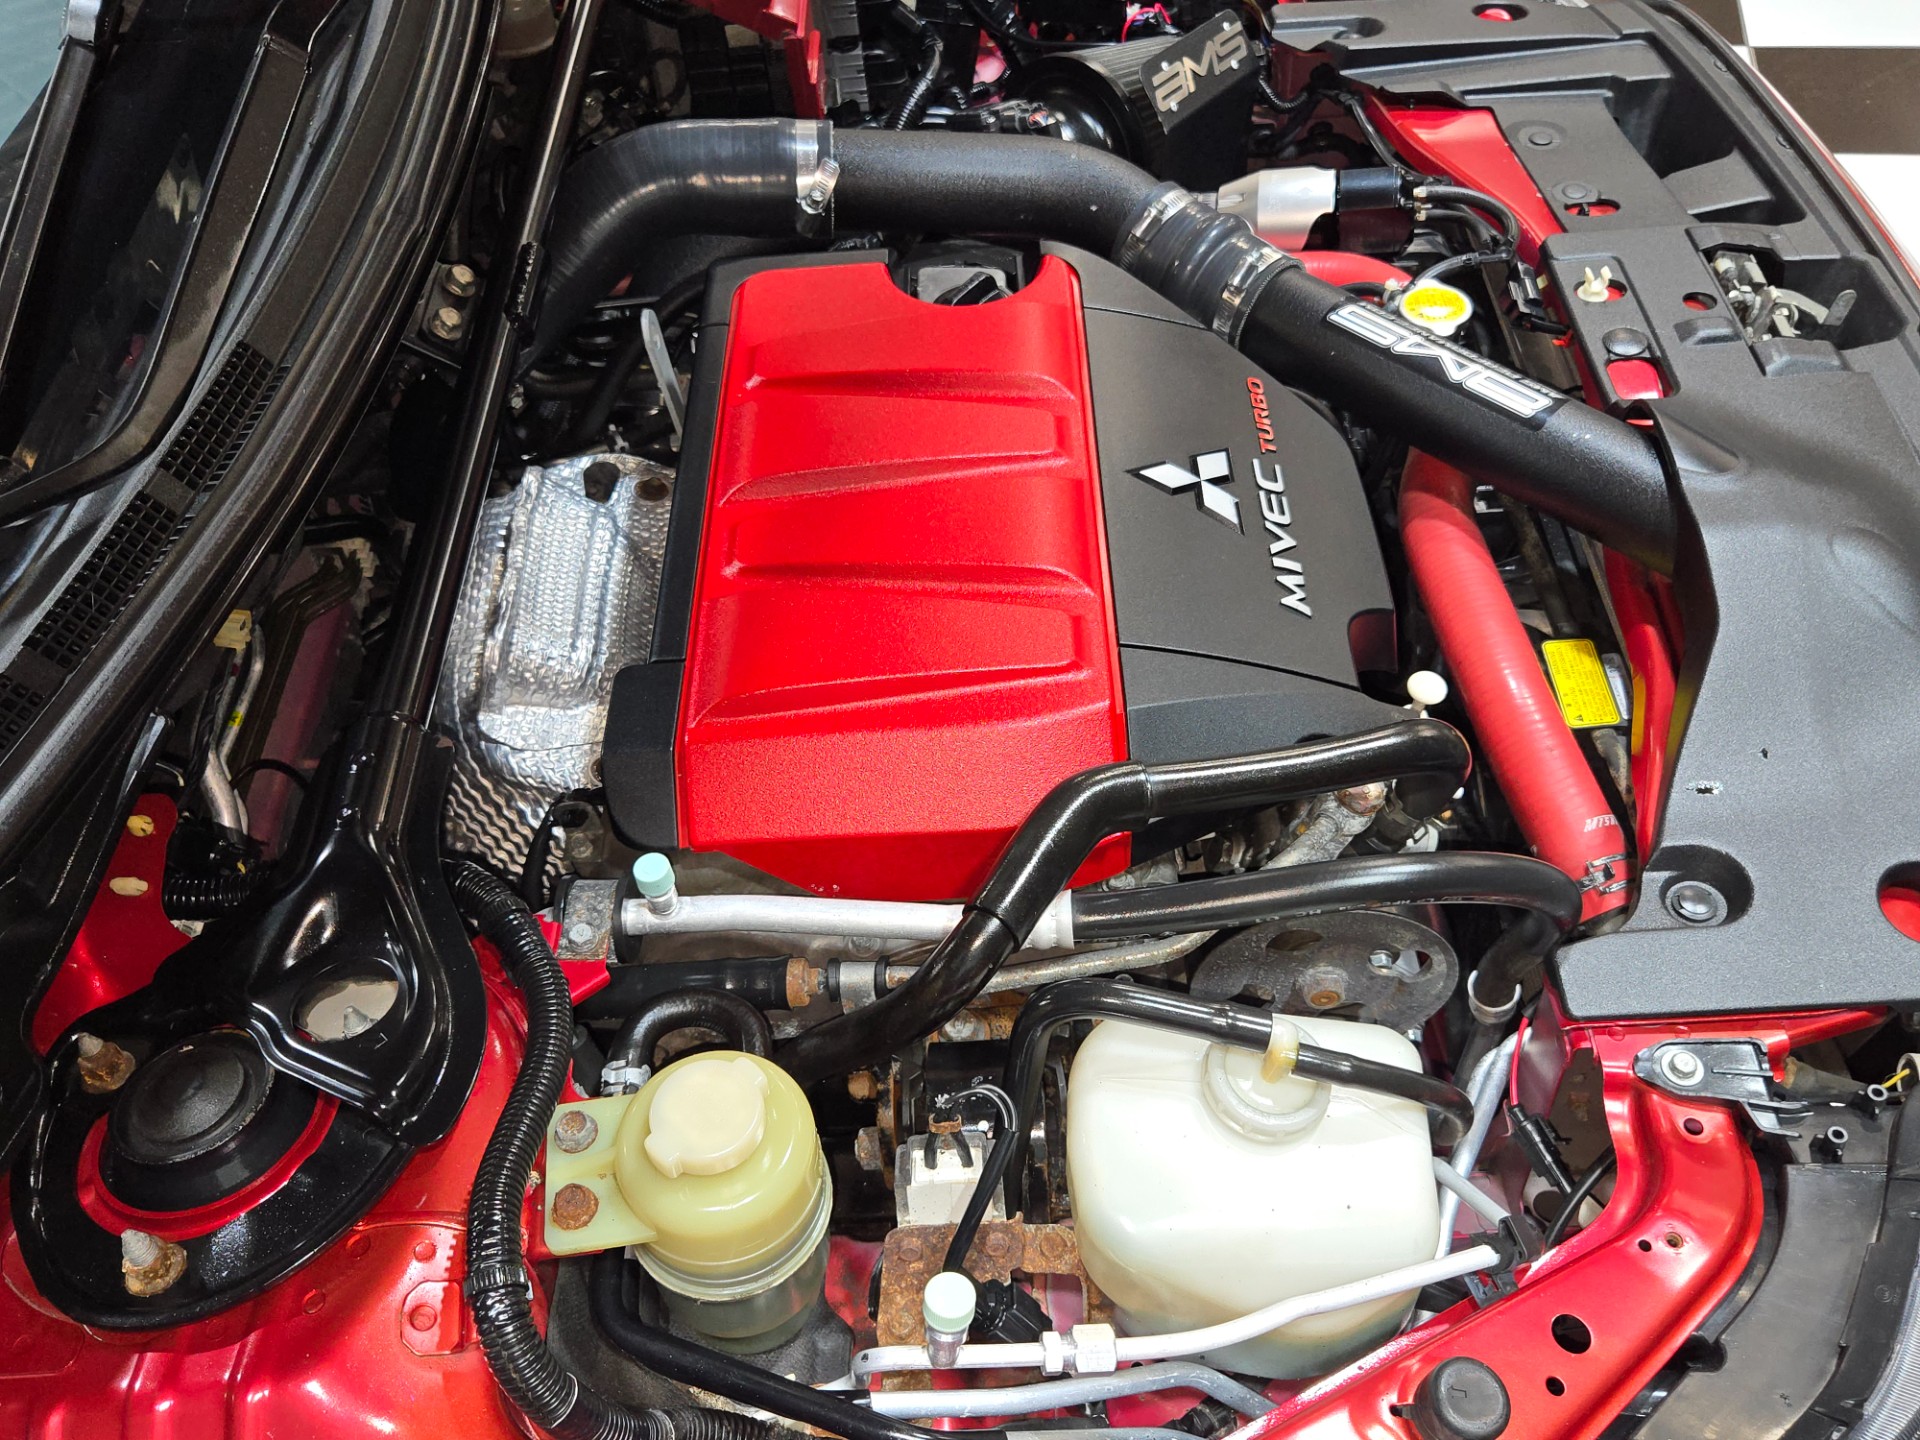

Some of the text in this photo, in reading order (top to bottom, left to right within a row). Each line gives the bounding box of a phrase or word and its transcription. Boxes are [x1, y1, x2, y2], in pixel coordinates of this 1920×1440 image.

[1152, 22, 1248, 112] AMS
[1326, 304, 1555, 418] AMS
[1246, 376, 1312, 619] MIVEC TURBO
